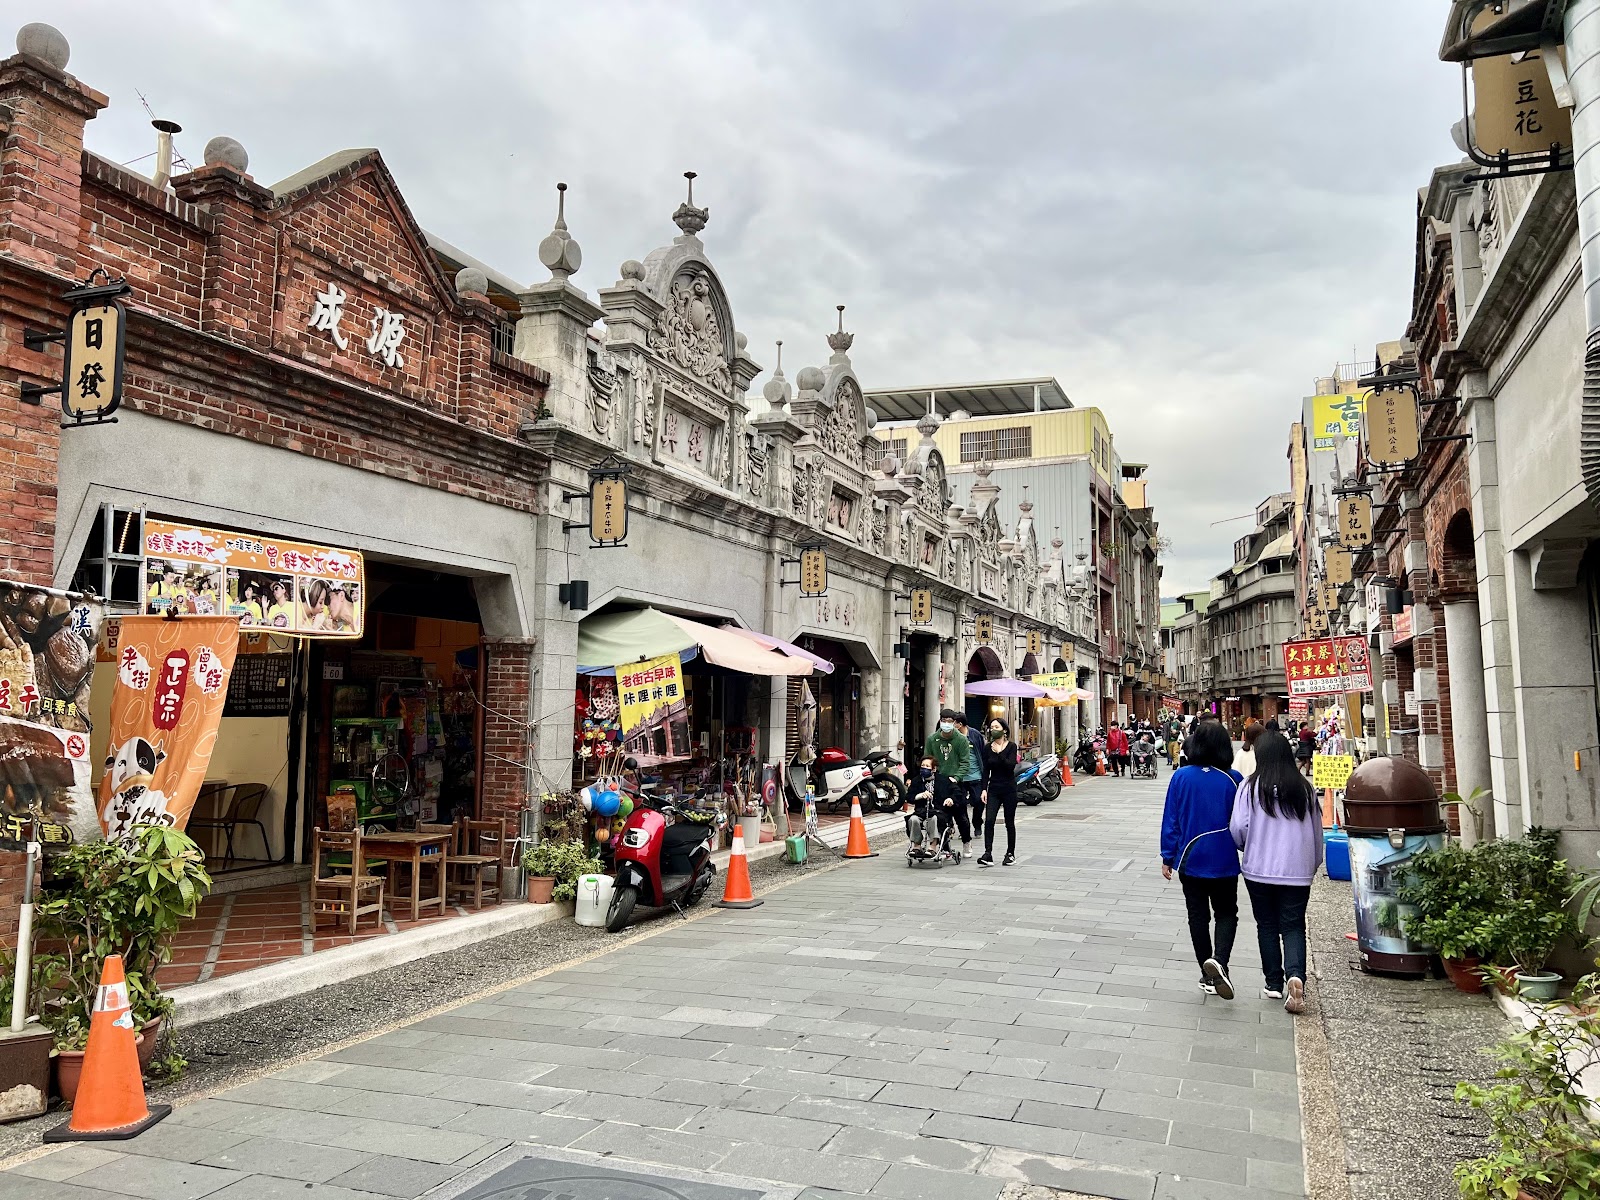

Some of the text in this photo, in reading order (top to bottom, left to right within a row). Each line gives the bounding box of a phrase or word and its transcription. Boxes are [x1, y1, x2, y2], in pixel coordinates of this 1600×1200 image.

[76, 318, 107, 400] 日發
[1347, 502, 1362, 530] 蔡記
[266, 545, 357, 578] 曾鮮木瓜牛奶
[980, 619, 990, 639] 和風
[1288, 644, 1347, 662] 大溪蔡記
[121, 646, 149, 690] 老街
[200, 647, 223, 693] 曾鮮
[329, 669, 340, 678] 60
[621, 665, 676, 688] 老街古早味
[159, 657, 187, 722] 正宗
[623, 683, 678, 706] 咔哩咔哩
[43, 697, 78, 717] 可素食
[0, 814, 73, 845] 干(葷)
